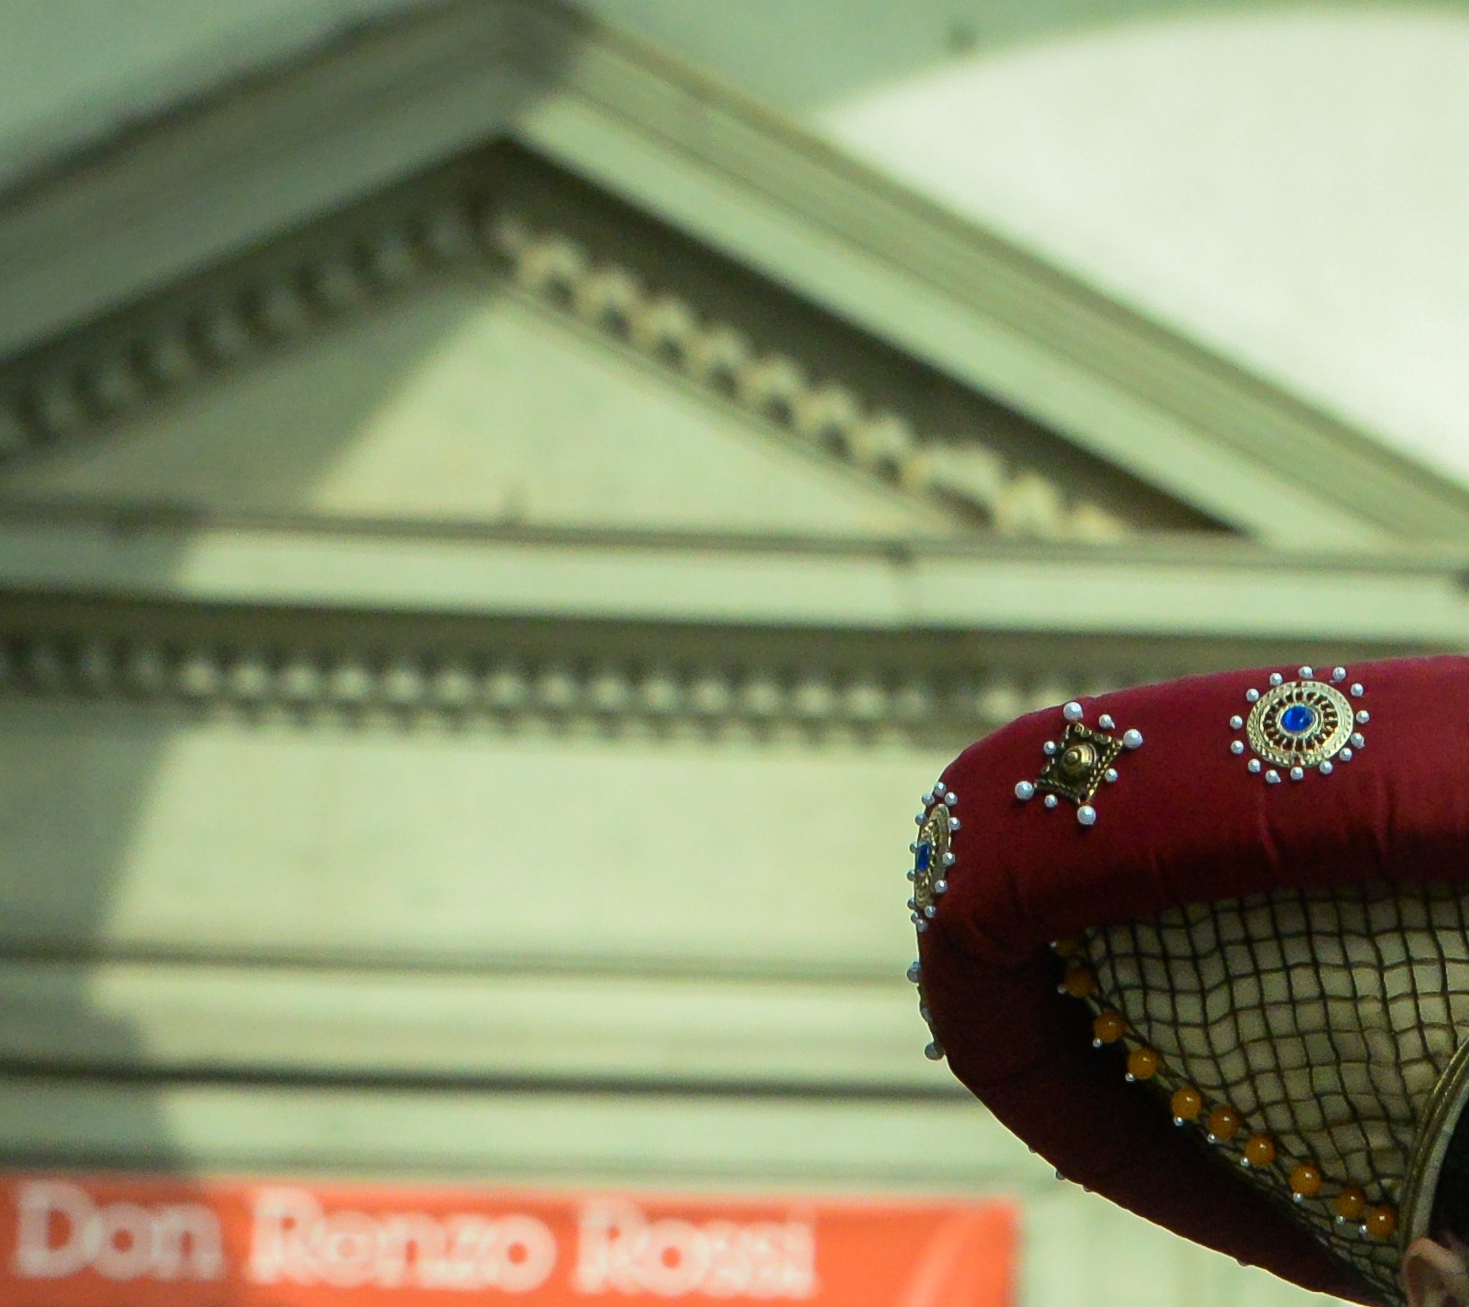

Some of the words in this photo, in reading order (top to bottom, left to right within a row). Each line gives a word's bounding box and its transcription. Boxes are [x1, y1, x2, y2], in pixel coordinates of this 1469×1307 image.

[14, 1182, 224, 1279] Don
[246, 1187, 557, 1293] Renzo
[570, 1195, 820, 1301] Rossi
